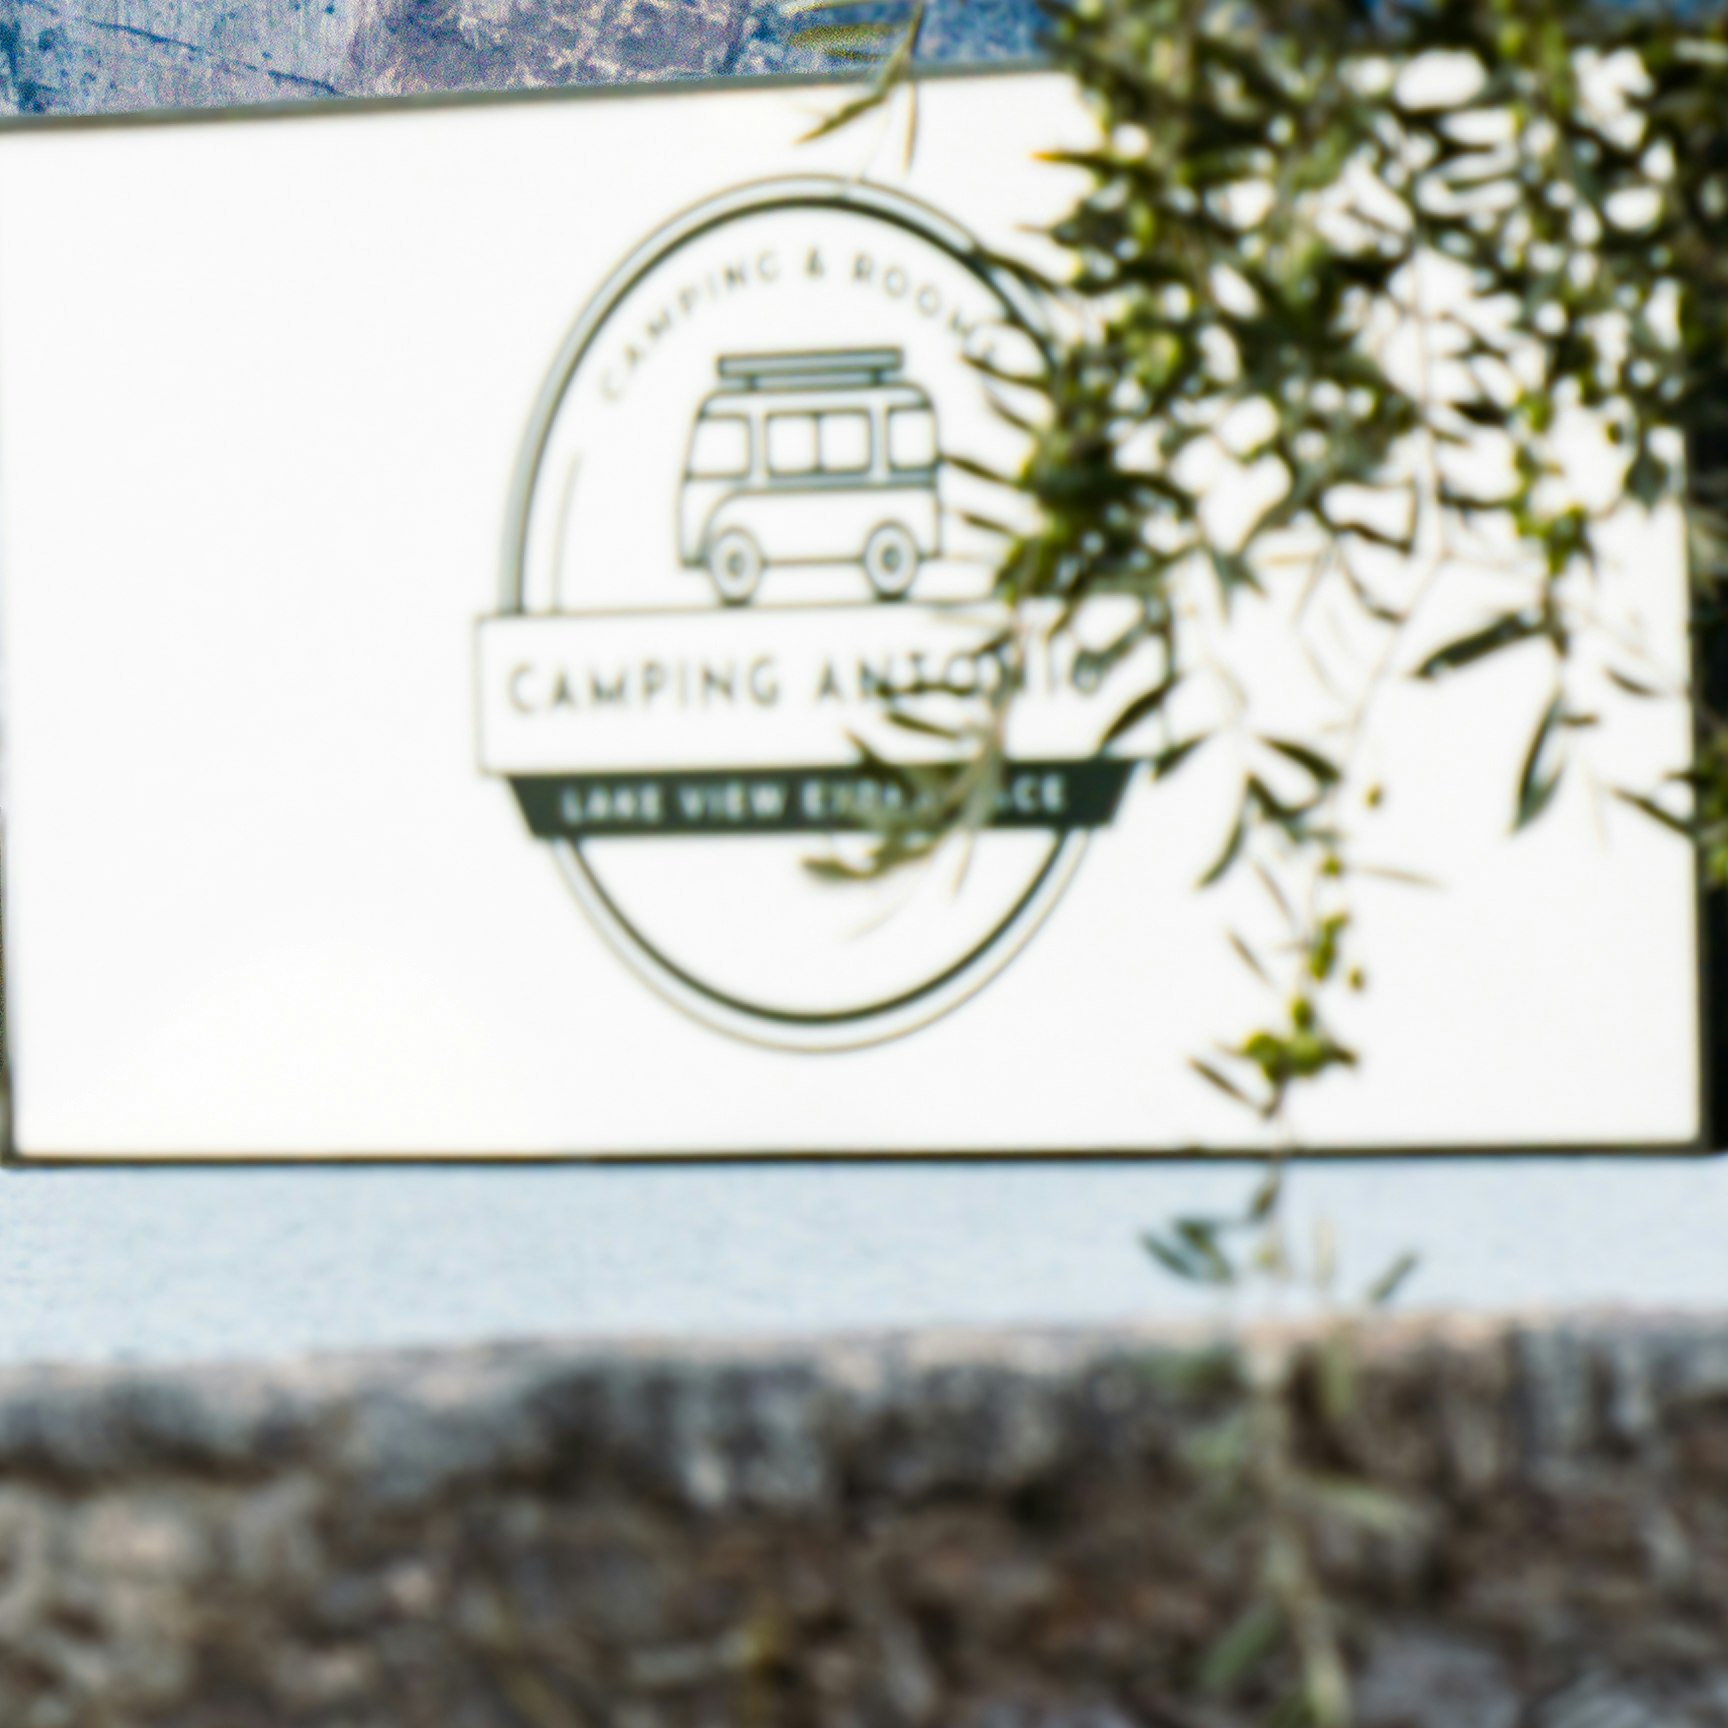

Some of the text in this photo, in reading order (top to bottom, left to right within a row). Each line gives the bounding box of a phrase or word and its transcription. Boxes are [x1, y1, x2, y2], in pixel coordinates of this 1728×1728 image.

[599, 250, 781, 402] CAMPING
[804, 247, 826, 280] &
[507, 654, 779, 715] CAMPING
[560, 782, 661, 825] LAKE
[676, 780, 788, 821] VIEW
